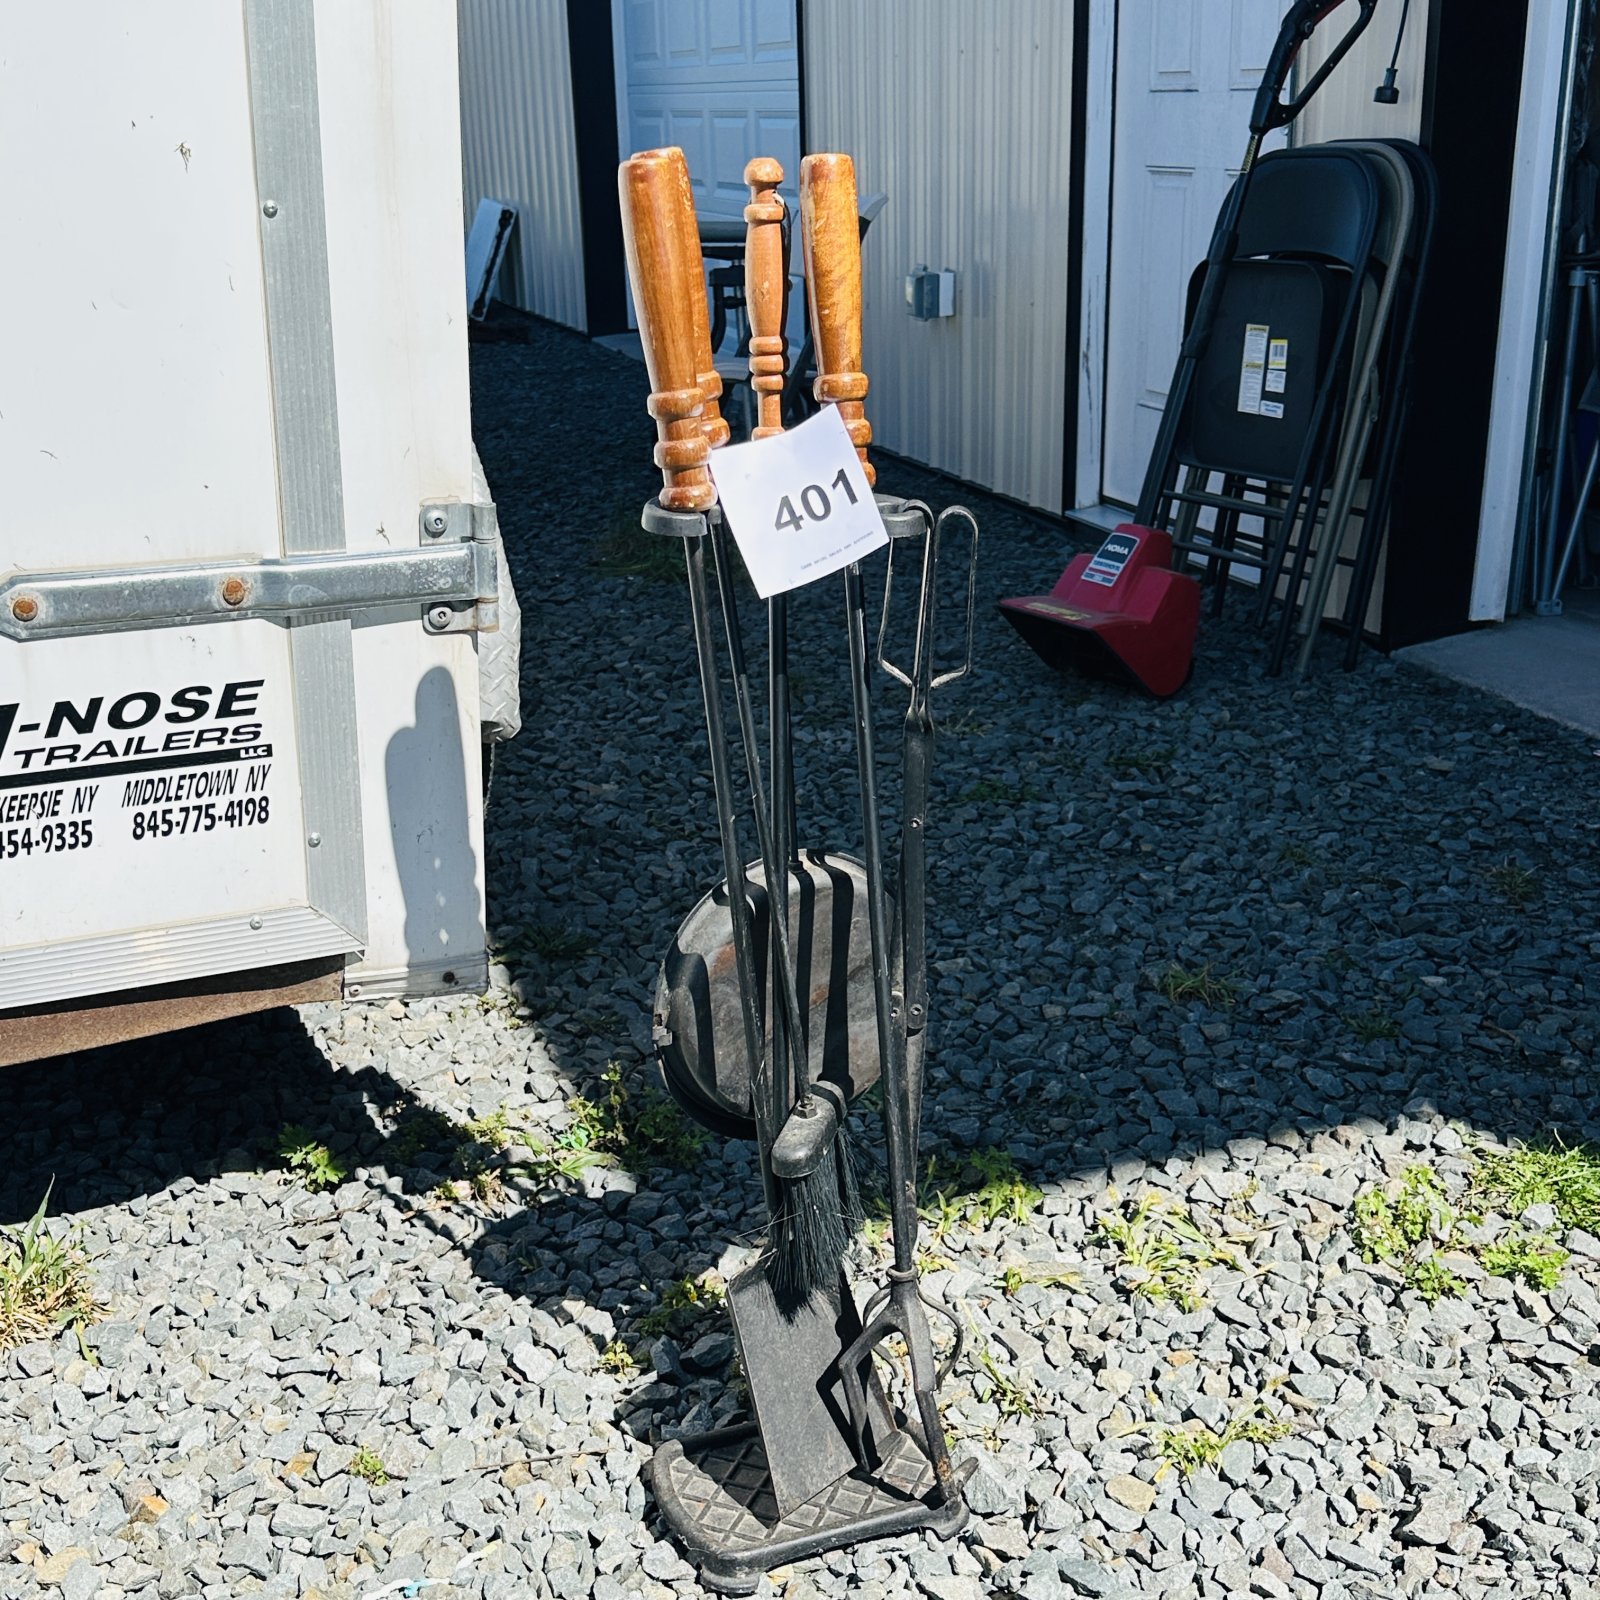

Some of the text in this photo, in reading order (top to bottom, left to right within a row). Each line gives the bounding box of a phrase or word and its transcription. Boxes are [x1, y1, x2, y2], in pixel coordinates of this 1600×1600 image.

[774, 468, 859, 532] 401
[13, 723, 263, 769] TRAILERS
[239, 746, 269, 759] LLC
[71, 784, 99, 815] NY
[121, 764, 271, 808] MIDDLETOWN NY
[132, 796, 270, 840] 845-775-4198
